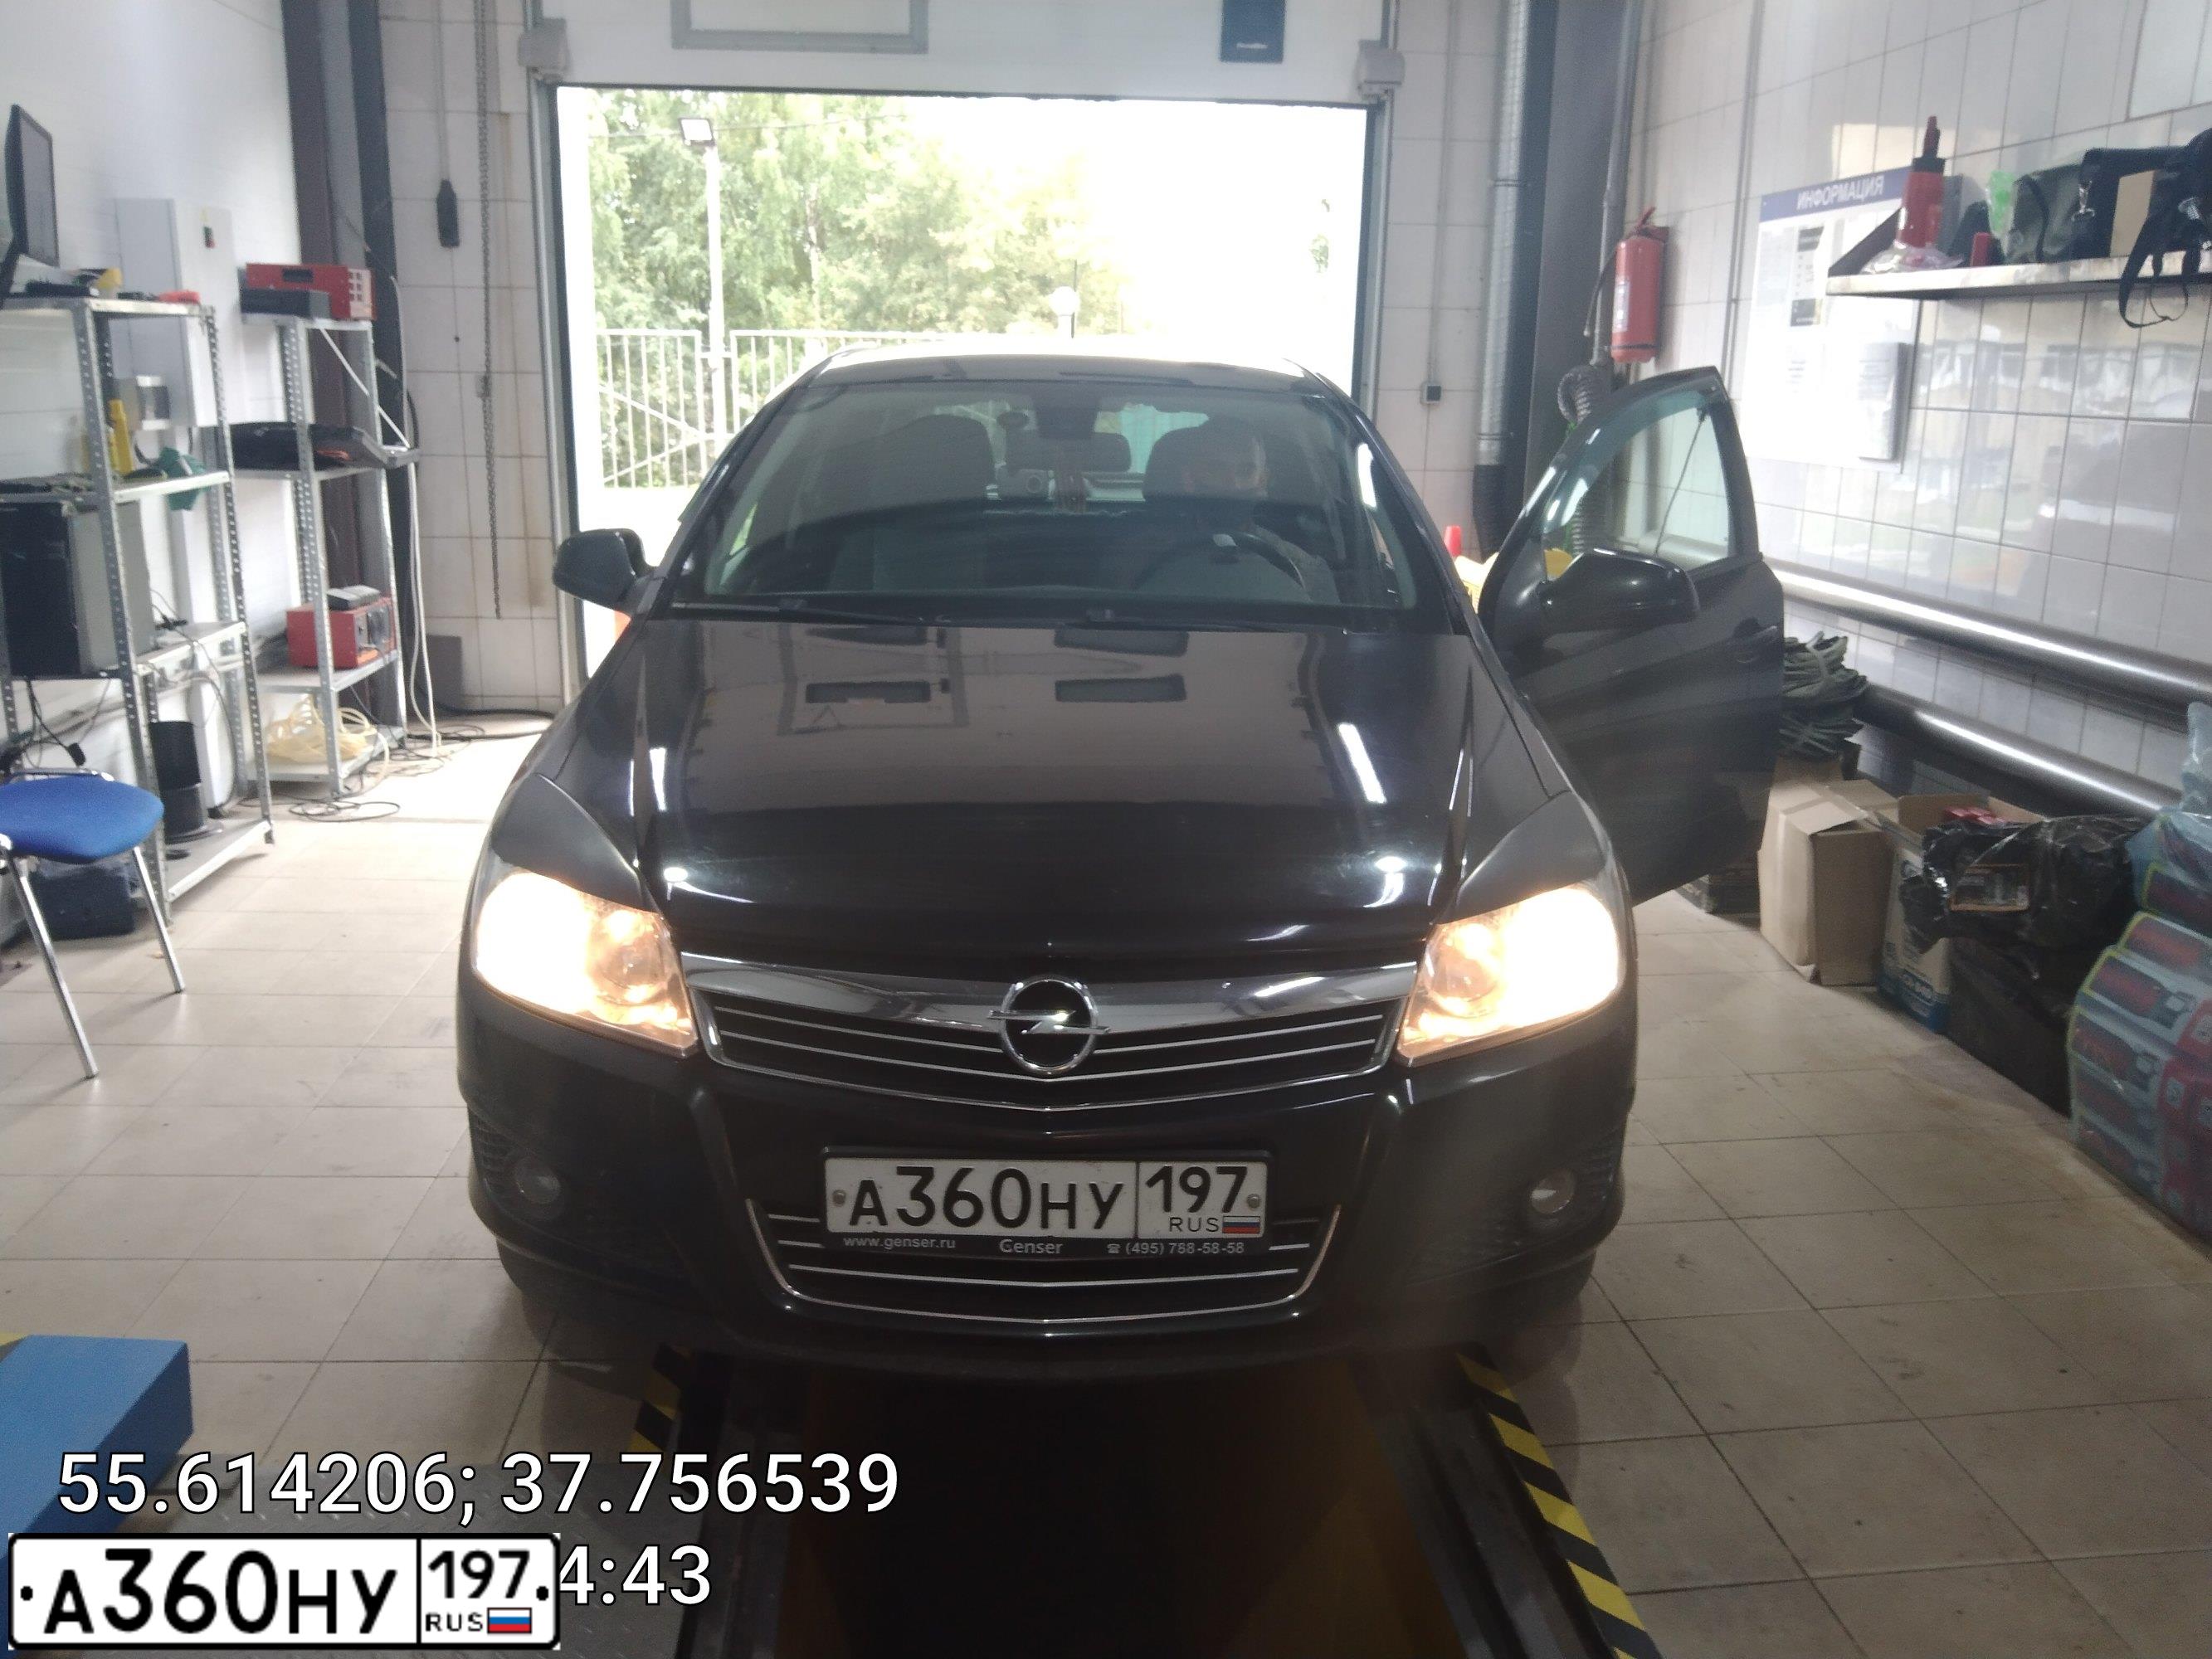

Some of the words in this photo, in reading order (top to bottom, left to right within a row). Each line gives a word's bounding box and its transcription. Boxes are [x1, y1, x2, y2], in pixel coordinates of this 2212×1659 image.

[1797, 176, 1884, 210] ИНФОРМАЦИЯ
[1145, 1165, 1247, 1213] 197
[1169, 1217, 1219, 1232] RUS
[843, 1236, 956, 1250] www.genser.ru
[1125, 1243, 1163, 1255] (495)
